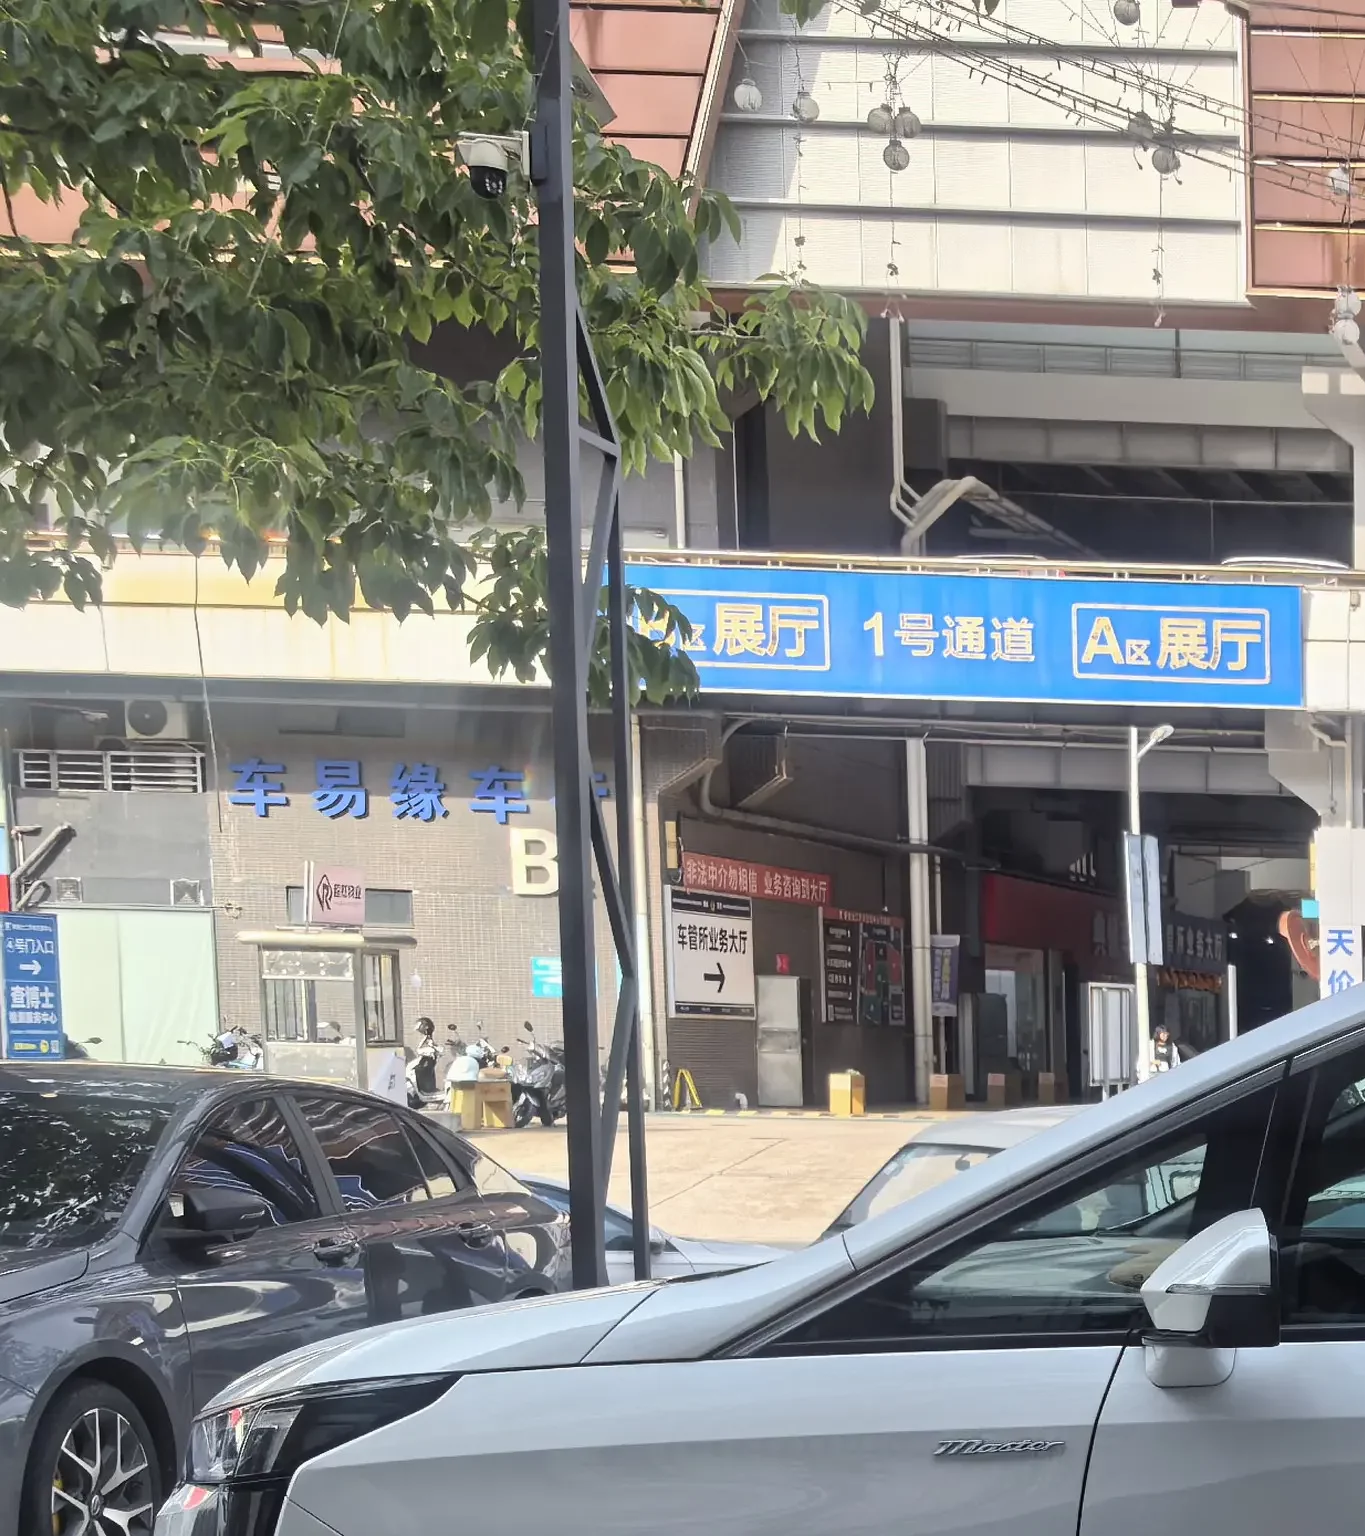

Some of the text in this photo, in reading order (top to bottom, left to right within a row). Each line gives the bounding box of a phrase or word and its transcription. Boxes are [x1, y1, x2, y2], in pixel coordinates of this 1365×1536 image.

[863, 611, 1036, 662] 1号通道
[1081, 615, 1262, 671] A区展厅
[509, 827, 559, 896] B
[686, 858, 827, 903] 非法中介勿相信 业务咨询到大厅
[677, 923, 748, 955] 车管所业务大厅
[932, 1439, 1065, 1456] Master
